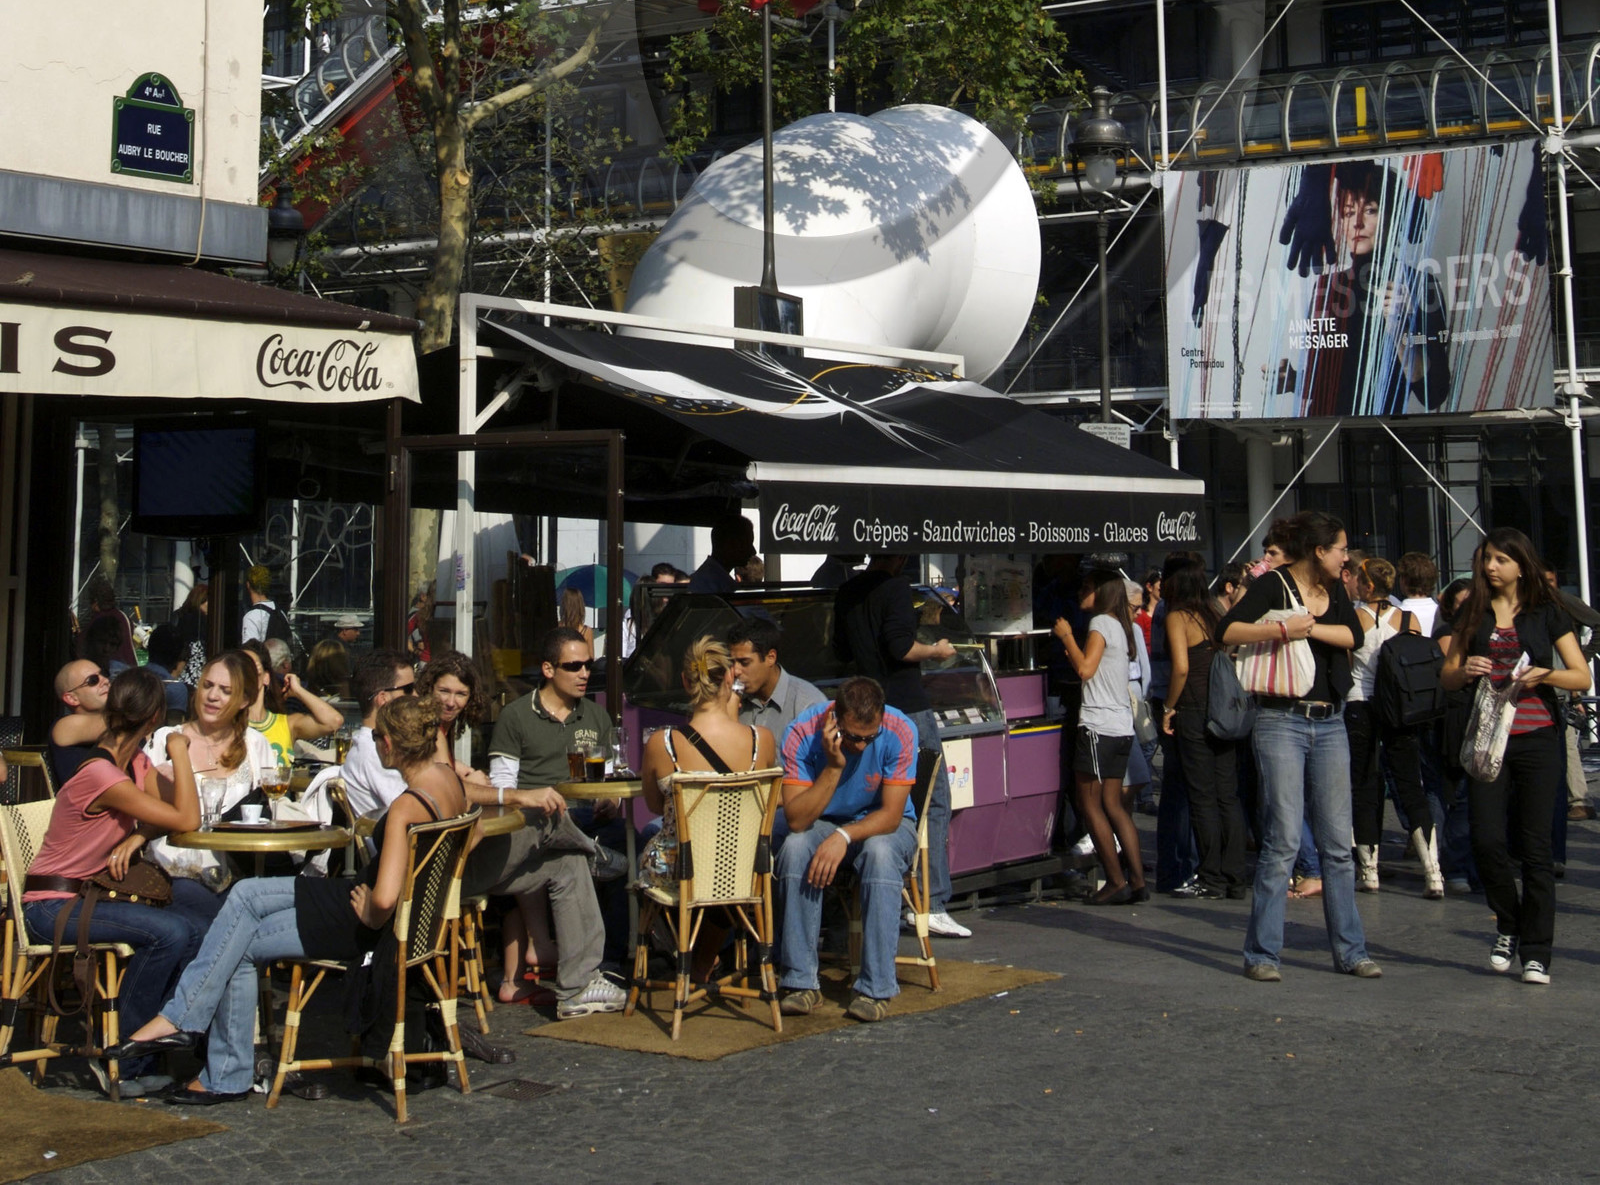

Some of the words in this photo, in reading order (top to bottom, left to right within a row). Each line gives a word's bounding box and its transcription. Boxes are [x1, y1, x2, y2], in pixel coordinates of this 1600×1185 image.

[147, 123, 162, 135] RUE
[118, 143, 141, 157] AUBRY
[143, 147, 153, 158] LE
[155, 149, 188, 163] BOUCHER
[1288, 317, 1336, 334] ANNETTE
[1289, 333, 1349, 350] MESSAGER
[1438, 329, 1450, 343] 17
[1181, 347, 1204, 357] Centre
[853, 518, 909, 548] Crêpes
[922, 519, 1016, 543] Sandwiches
[1028, 522, 1090, 543] Boissons
[1104, 522, 1149, 543] Glaces
